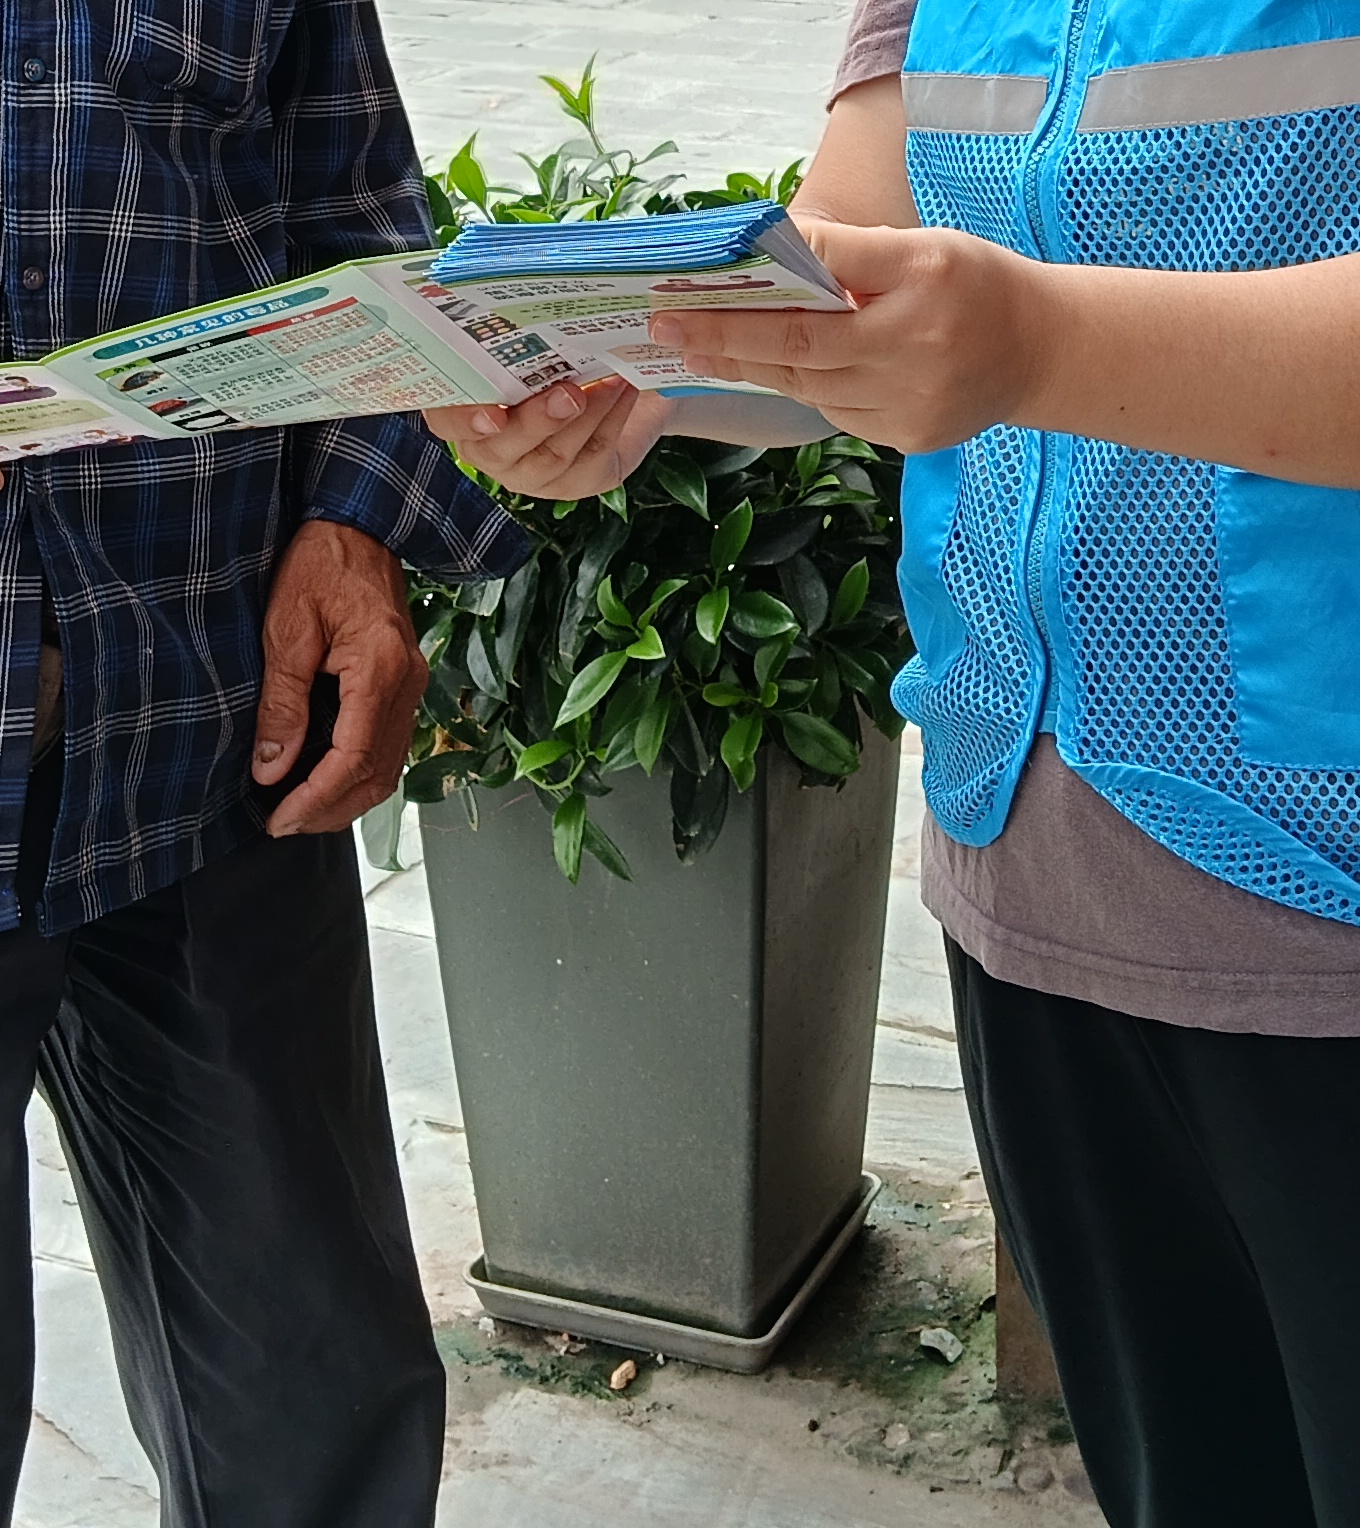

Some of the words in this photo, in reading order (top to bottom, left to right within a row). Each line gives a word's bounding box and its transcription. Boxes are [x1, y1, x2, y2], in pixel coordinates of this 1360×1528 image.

[136, 299, 290, 349] 几种常见的毒品
